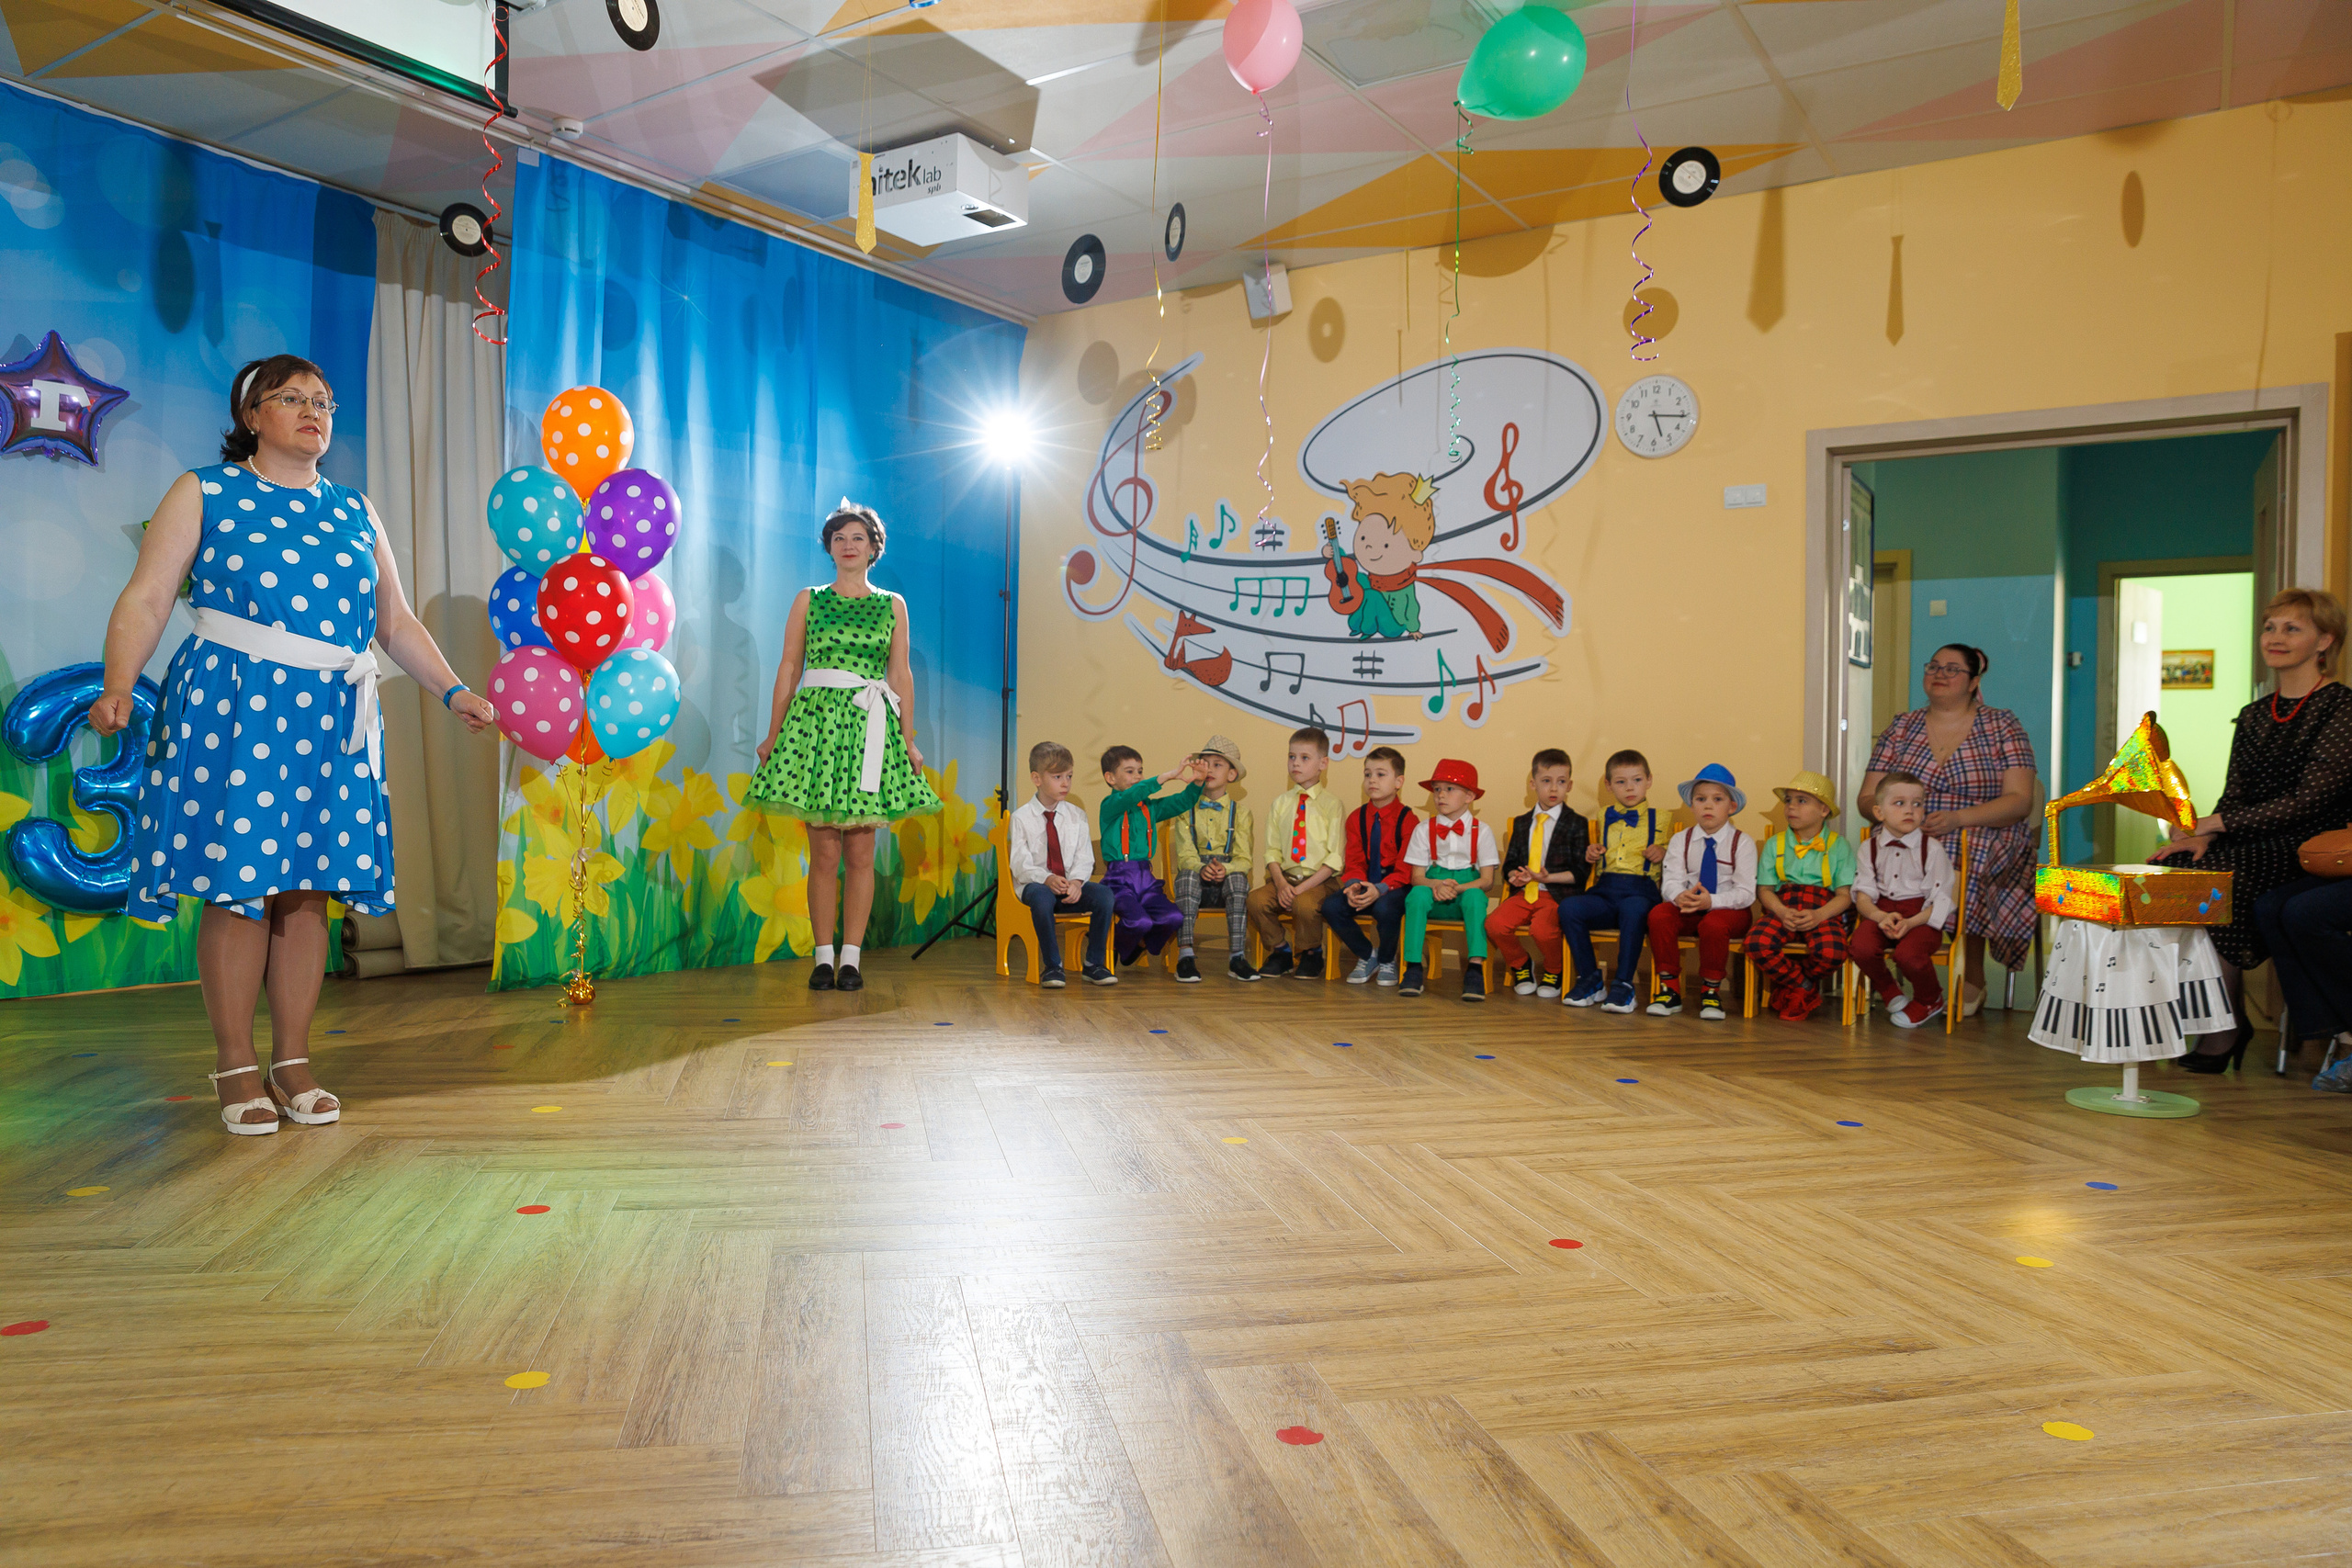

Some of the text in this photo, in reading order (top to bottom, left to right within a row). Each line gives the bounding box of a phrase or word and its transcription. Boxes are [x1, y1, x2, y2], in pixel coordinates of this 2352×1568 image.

[922, 166, 942, 185] lab
[1641, 389, 1647, 398] 11
[1653, 385, 1660, 394] 12
[1668, 388, 1672, 396] 1
[1631, 400, 1639, 408] 10
[1675, 397, 1681, 406] 2
[1637, 434, 1644, 443] 7
[1651, 438, 1657, 446] 6
[1666, 433, 1673, 442] 5
